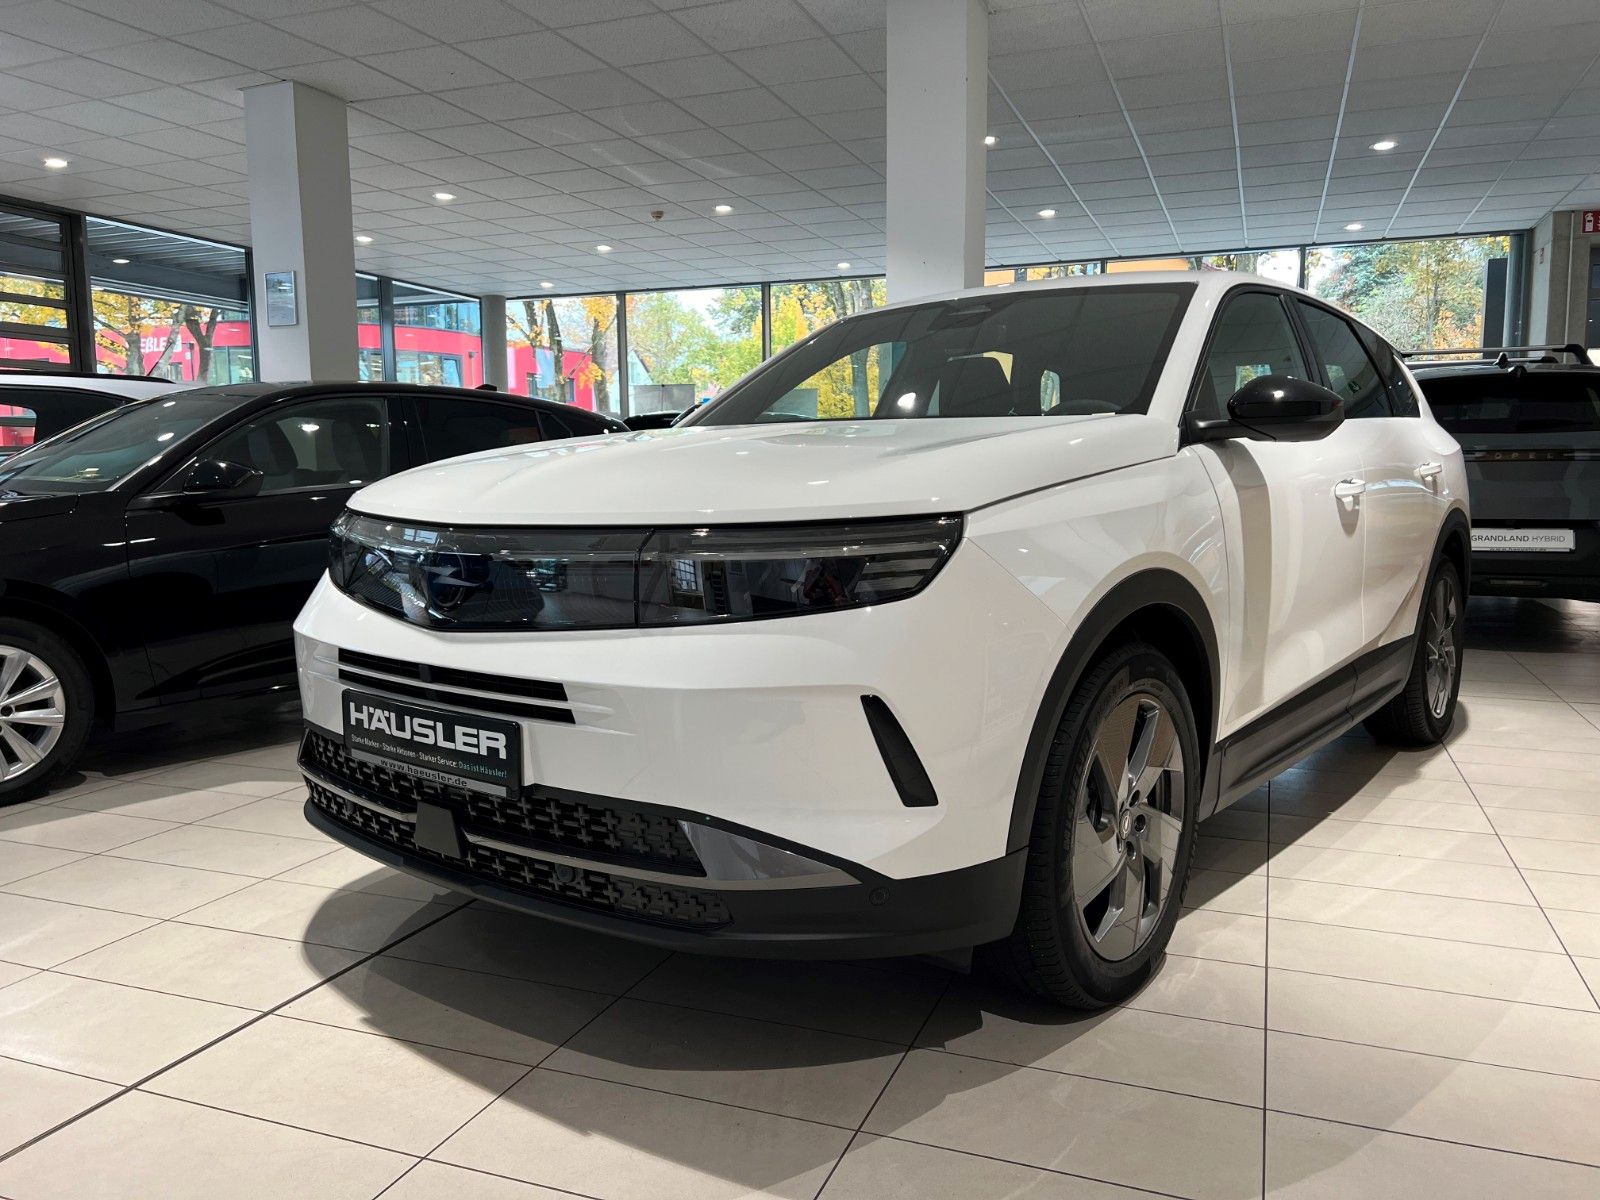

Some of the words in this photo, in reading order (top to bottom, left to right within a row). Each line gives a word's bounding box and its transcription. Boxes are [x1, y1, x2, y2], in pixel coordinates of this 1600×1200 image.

[1494, 451, 1554, 460] OPEL
[1471, 534, 1530, 542] GRANDLAND
[1531, 534, 1566, 543] HYBRID
[349, 702, 507, 760] HÄUSLER
[380, 759, 467, 787] www.haeusler.de
[418, 751, 437, 763] Starker
[458, 760, 470, 771] Das
[479, 764, 507, 778] Häusler!
